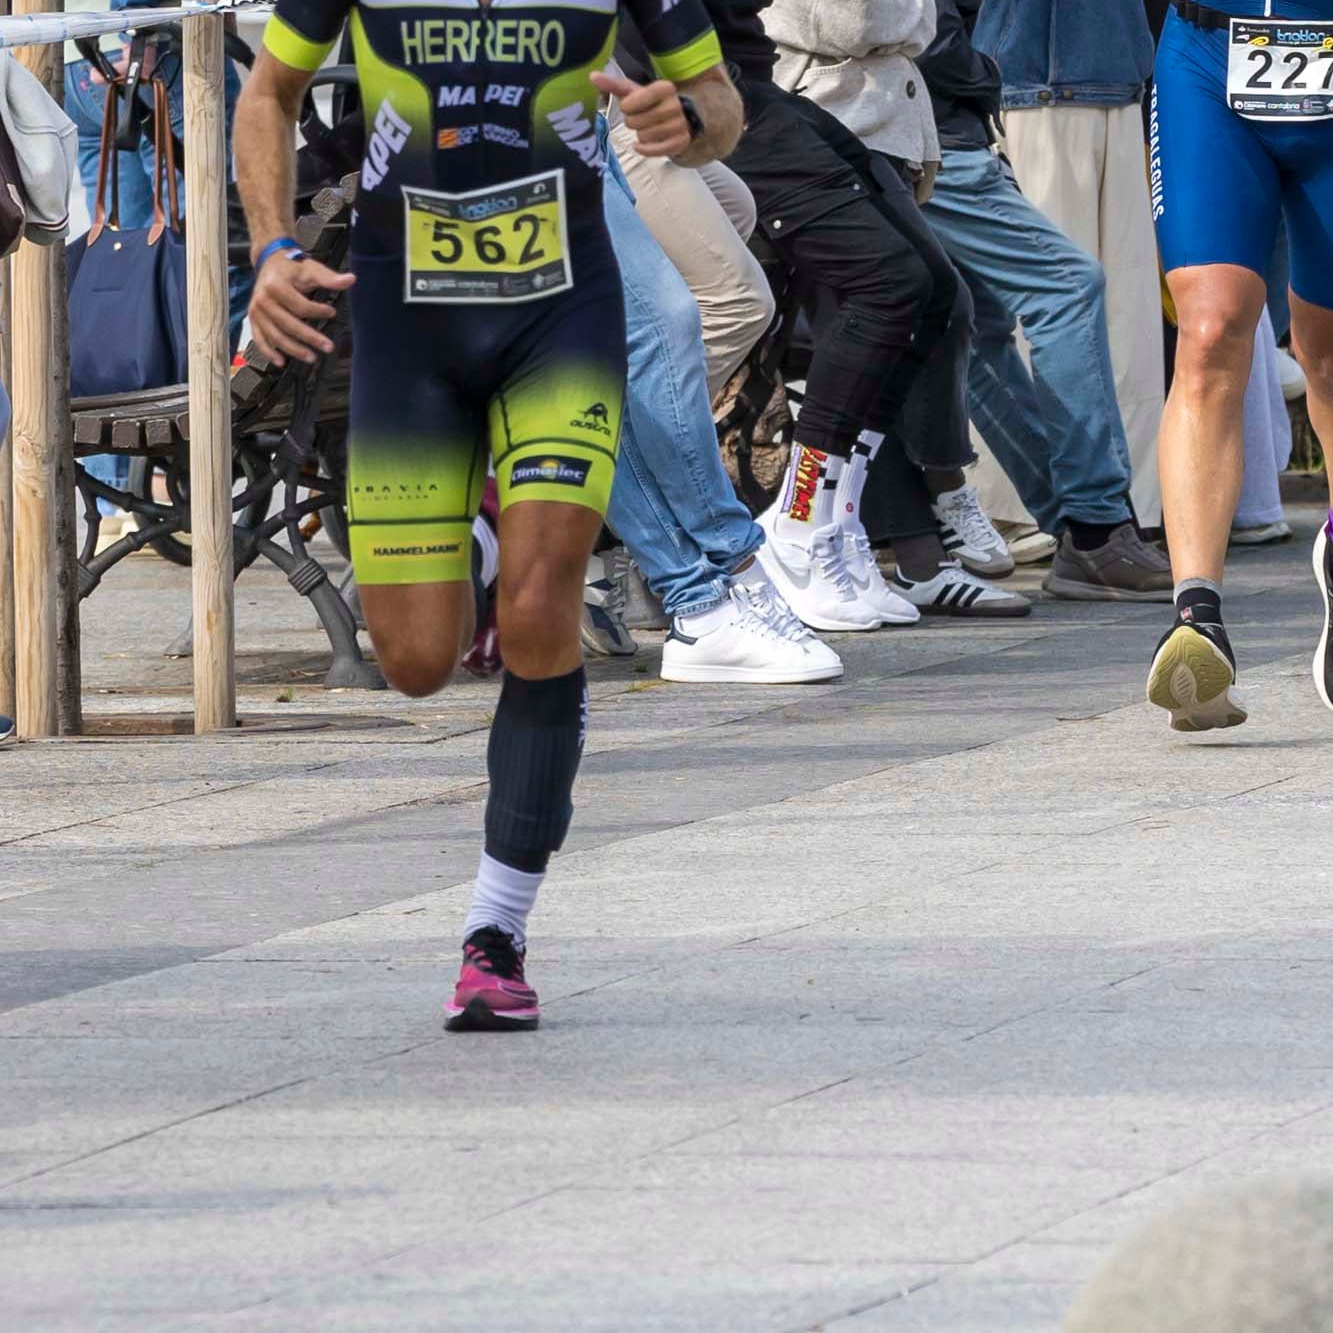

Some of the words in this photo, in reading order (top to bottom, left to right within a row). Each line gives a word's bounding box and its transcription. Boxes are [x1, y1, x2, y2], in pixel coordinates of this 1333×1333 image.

[401, 20, 565, 66] HERRERO
[438, 84, 527, 107] MAPEI
[361, 98, 412, 192] APEI
[1150, 83, 1165, 221] TRAGALEGUAS
[432, 213, 544, 265] 562
